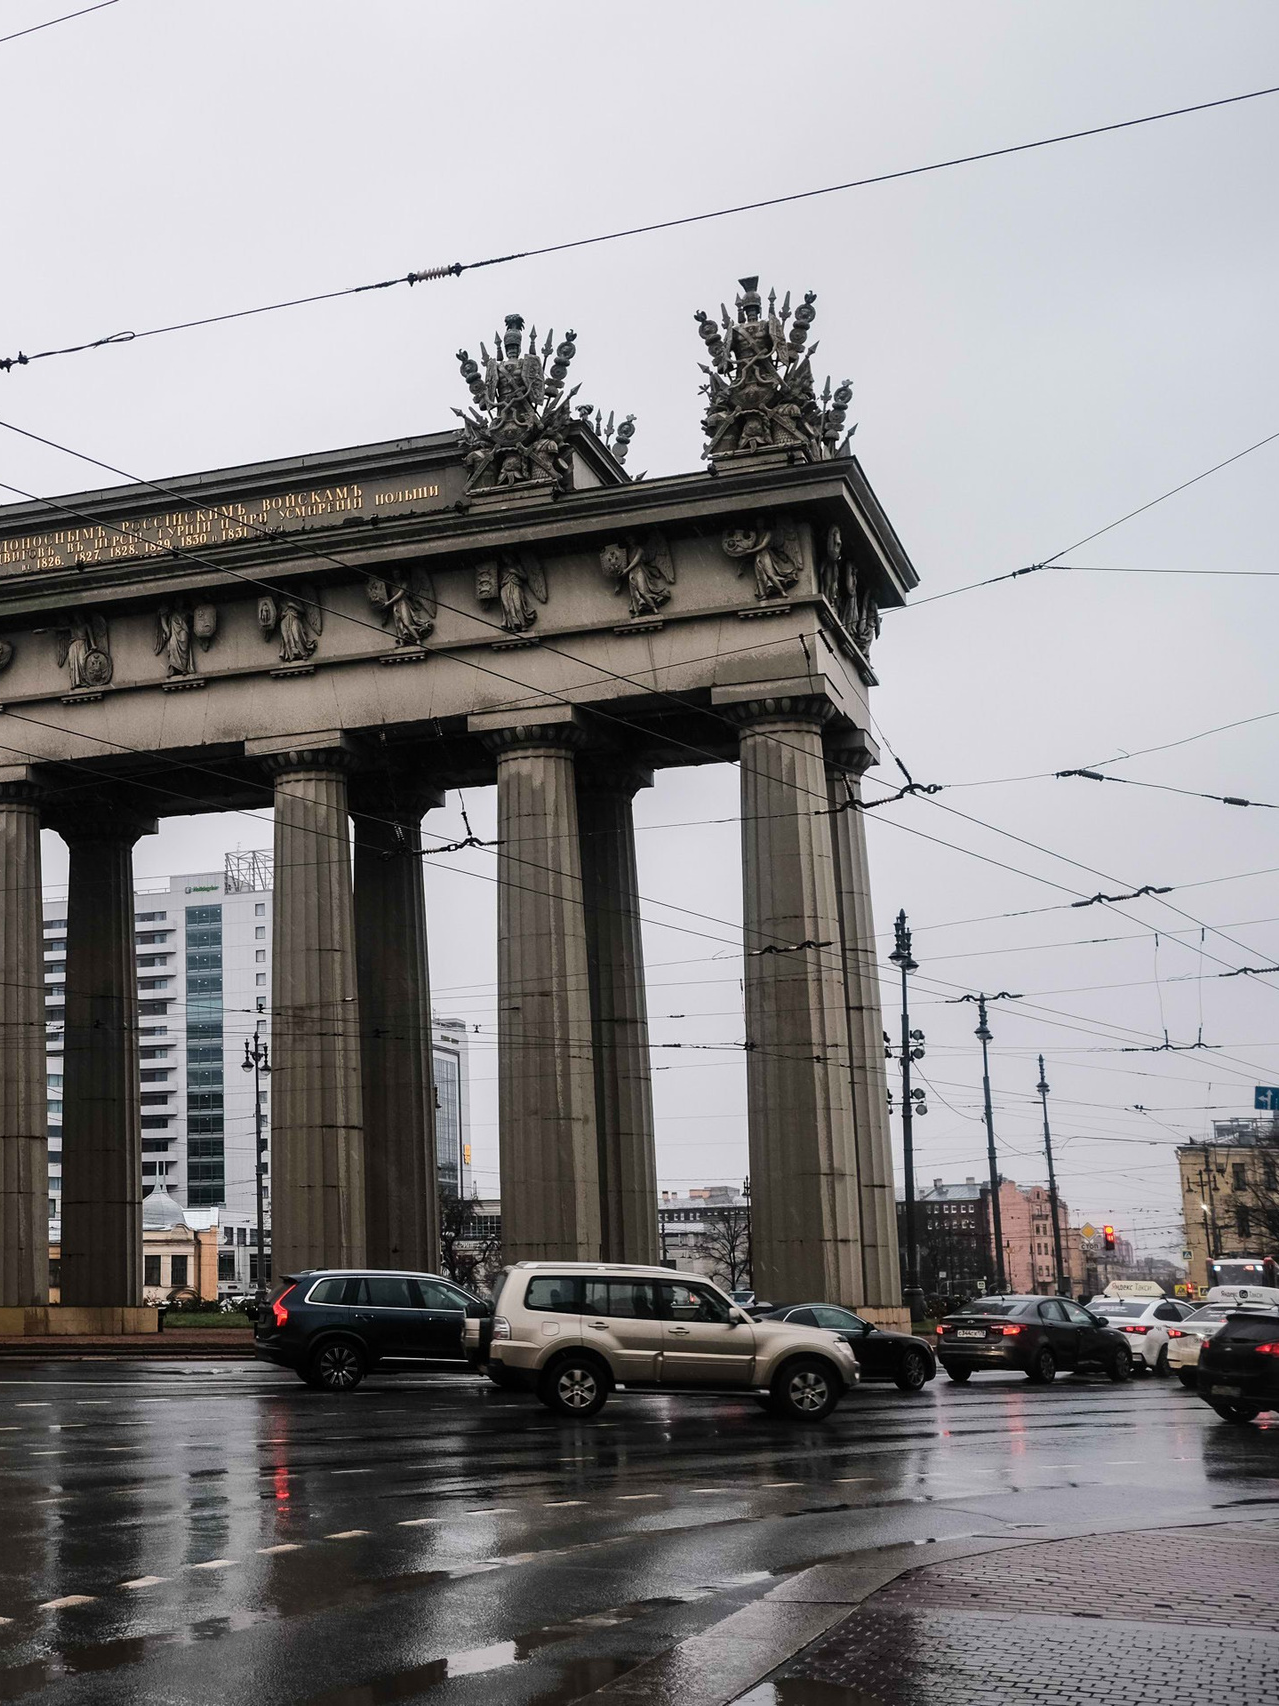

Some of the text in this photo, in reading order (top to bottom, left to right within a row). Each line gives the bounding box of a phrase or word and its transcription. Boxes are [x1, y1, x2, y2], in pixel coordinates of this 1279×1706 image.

[262, 484, 363, 512] ВОЙСКАМЪ
[67, 540, 84, 553] ВЪ
[375, 484, 439, 506] ПОЛЬШИ
[36, 555, 65, 569] 1826.
[109, 545, 139, 558] 1828.
[181, 533, 207, 547] 1830
[222, 527, 247, 541] 1831
[1111, 1281, 1152, 1292] Яндекс Такси
